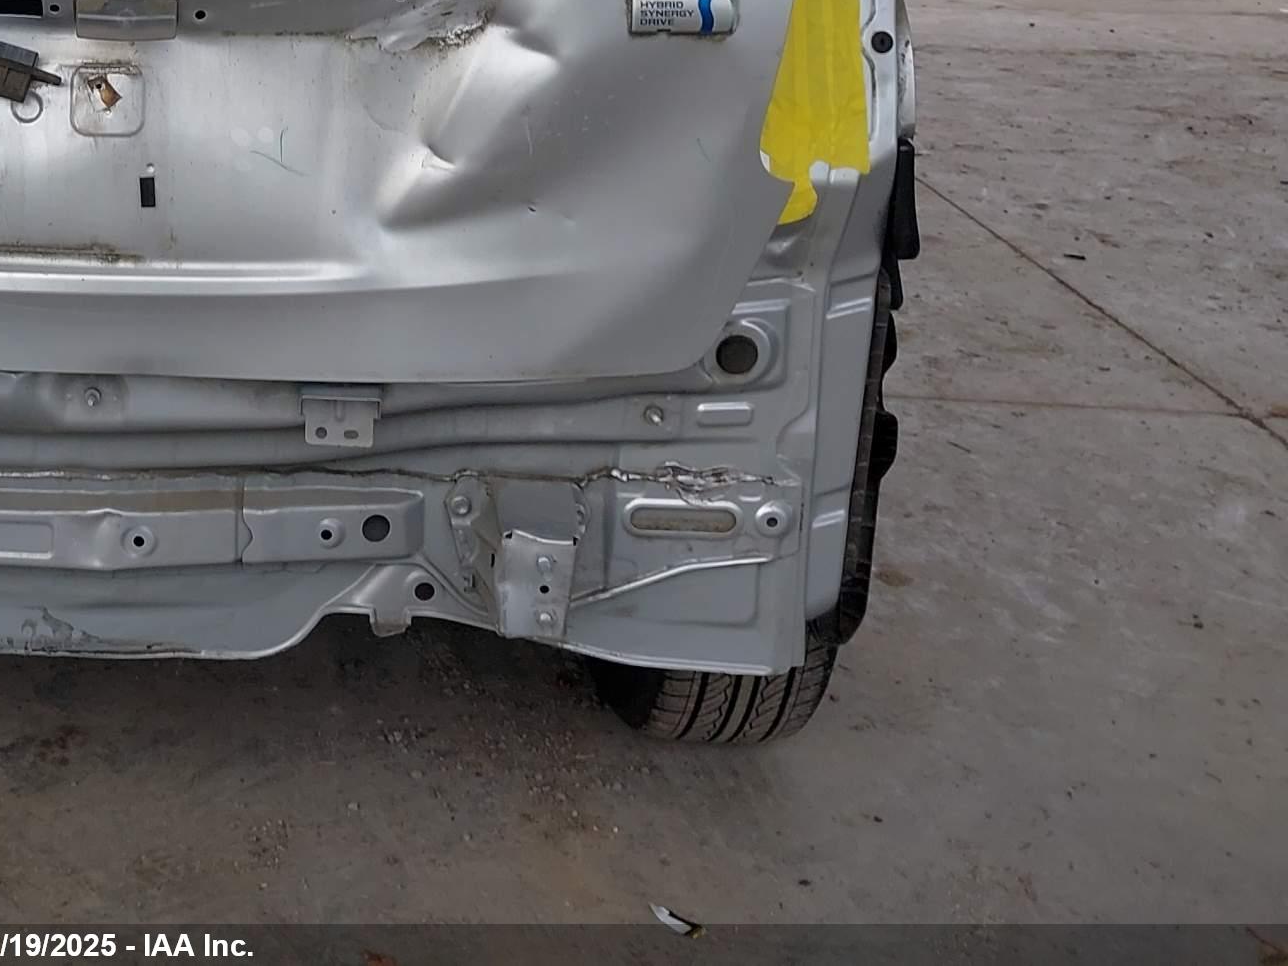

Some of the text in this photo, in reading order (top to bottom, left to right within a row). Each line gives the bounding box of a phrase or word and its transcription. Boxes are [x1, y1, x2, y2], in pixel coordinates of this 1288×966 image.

[640, 0, 684, 9] HYBRID
[640, 9, 694, 18] SYNERGY
[640, 18, 673, 26] DRIVE
